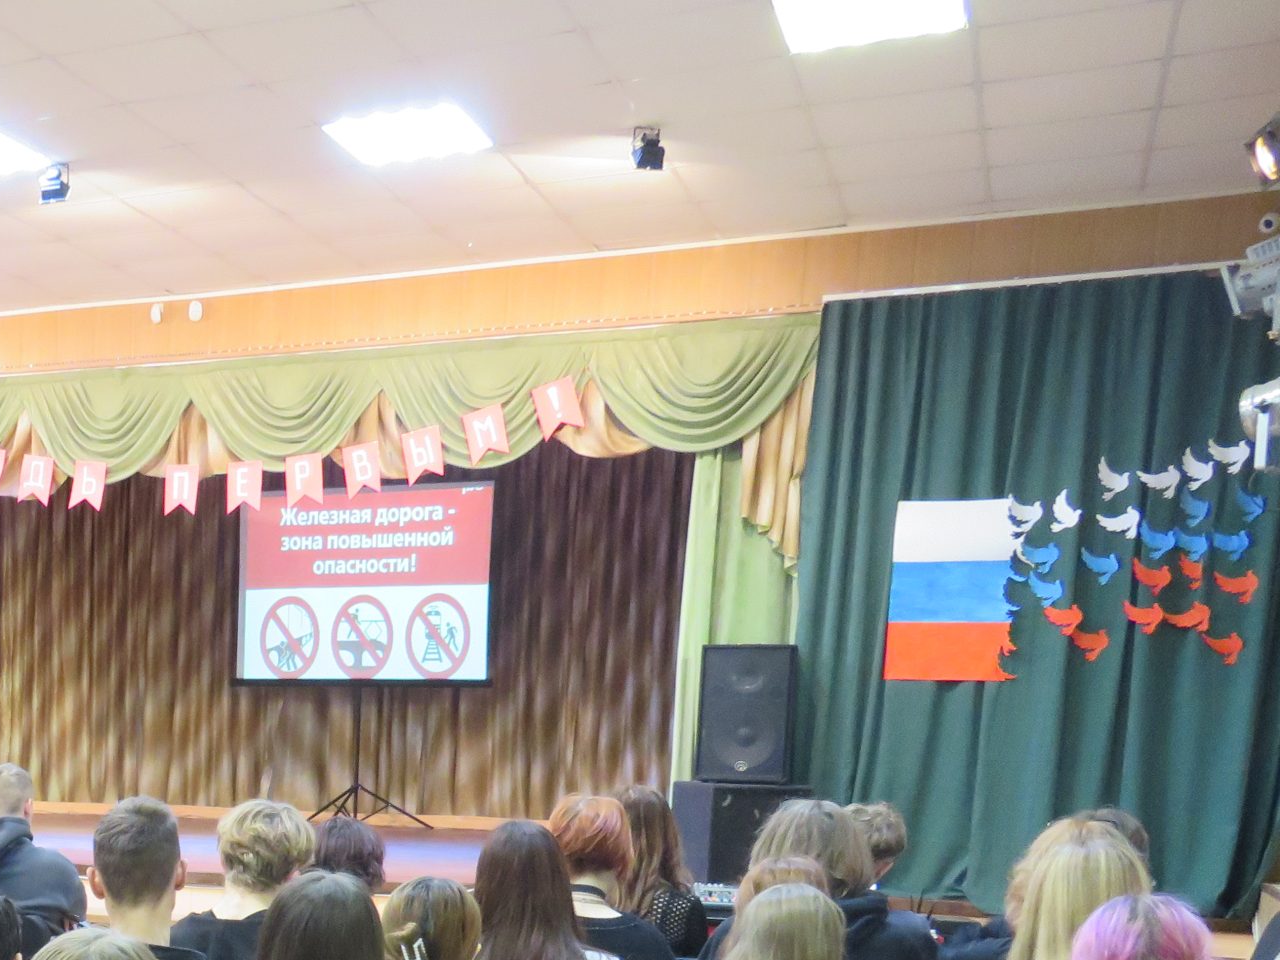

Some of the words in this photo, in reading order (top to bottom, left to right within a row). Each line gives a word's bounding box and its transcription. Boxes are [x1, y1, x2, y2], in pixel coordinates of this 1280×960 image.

[280, 506, 371, 527] Железная
[375, 504, 443, 527] дорога
[280, 535, 323, 552] зона
[327, 526, 454, 550] повышенной
[312, 554, 417, 575] опасности!
